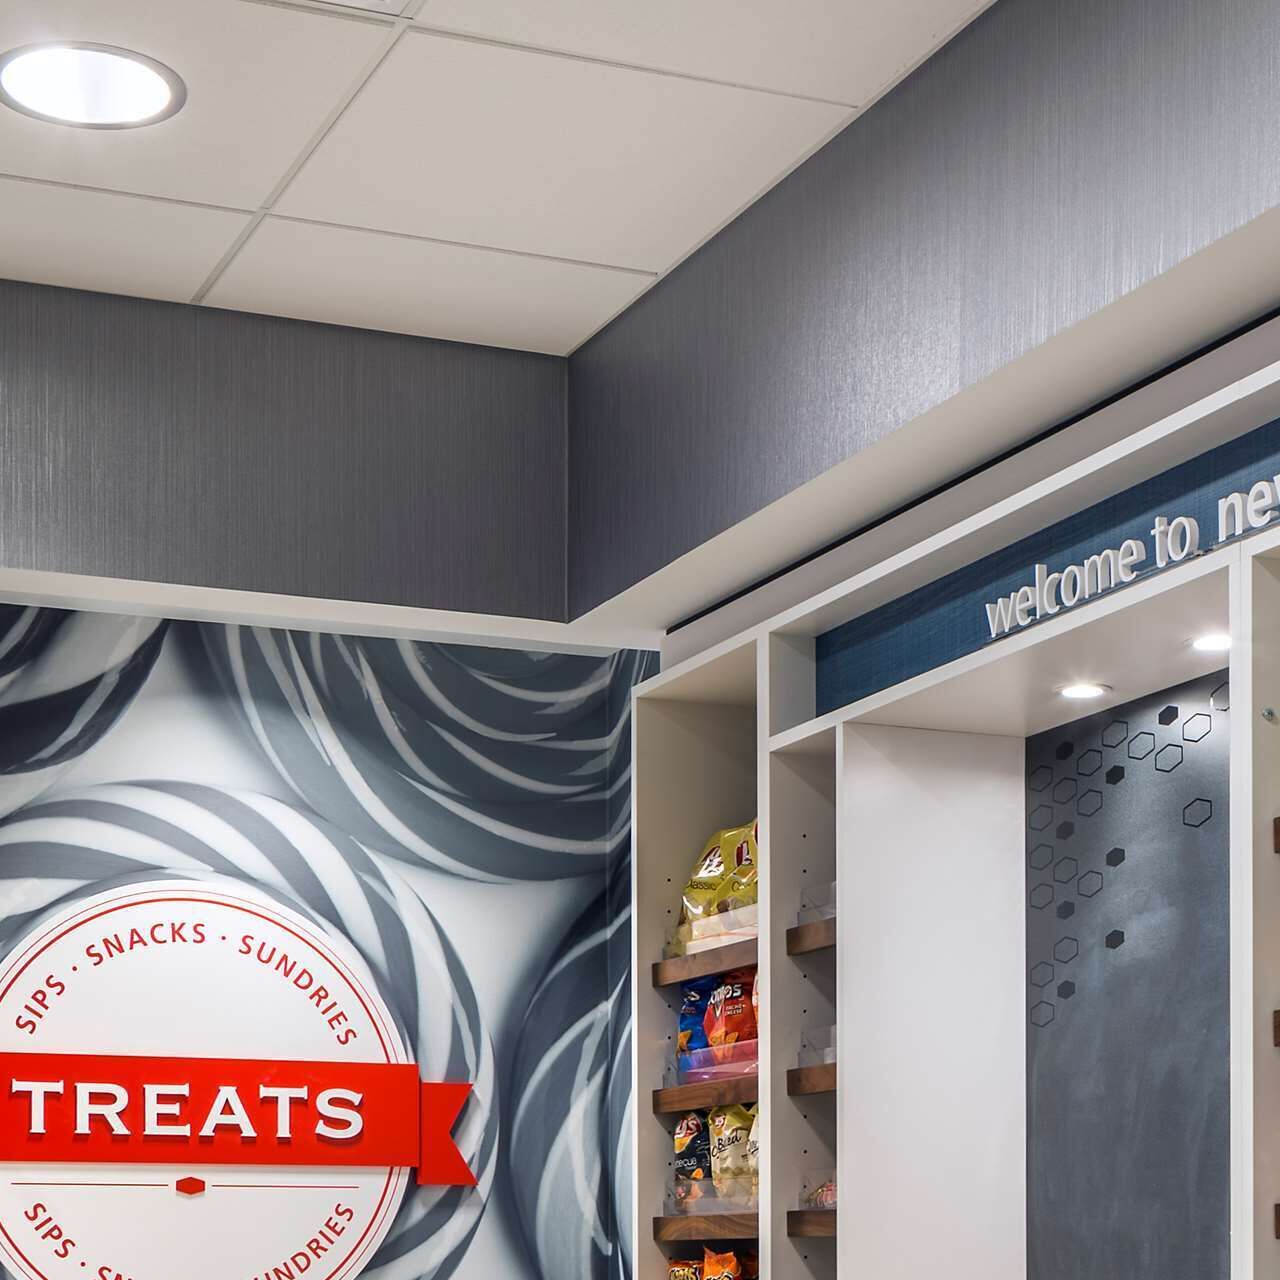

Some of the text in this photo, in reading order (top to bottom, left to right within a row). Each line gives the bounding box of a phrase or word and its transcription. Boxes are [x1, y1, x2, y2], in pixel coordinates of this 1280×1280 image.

[985, 538, 1145, 638] welcome
[1151, 515, 1200, 568] to
[15, 922, 357, 1047] SIPS SNACKS SUNDRIES
[11, 1077, 366, 1142] TREATS
[23, 1202, 76, 1260] SIPS
